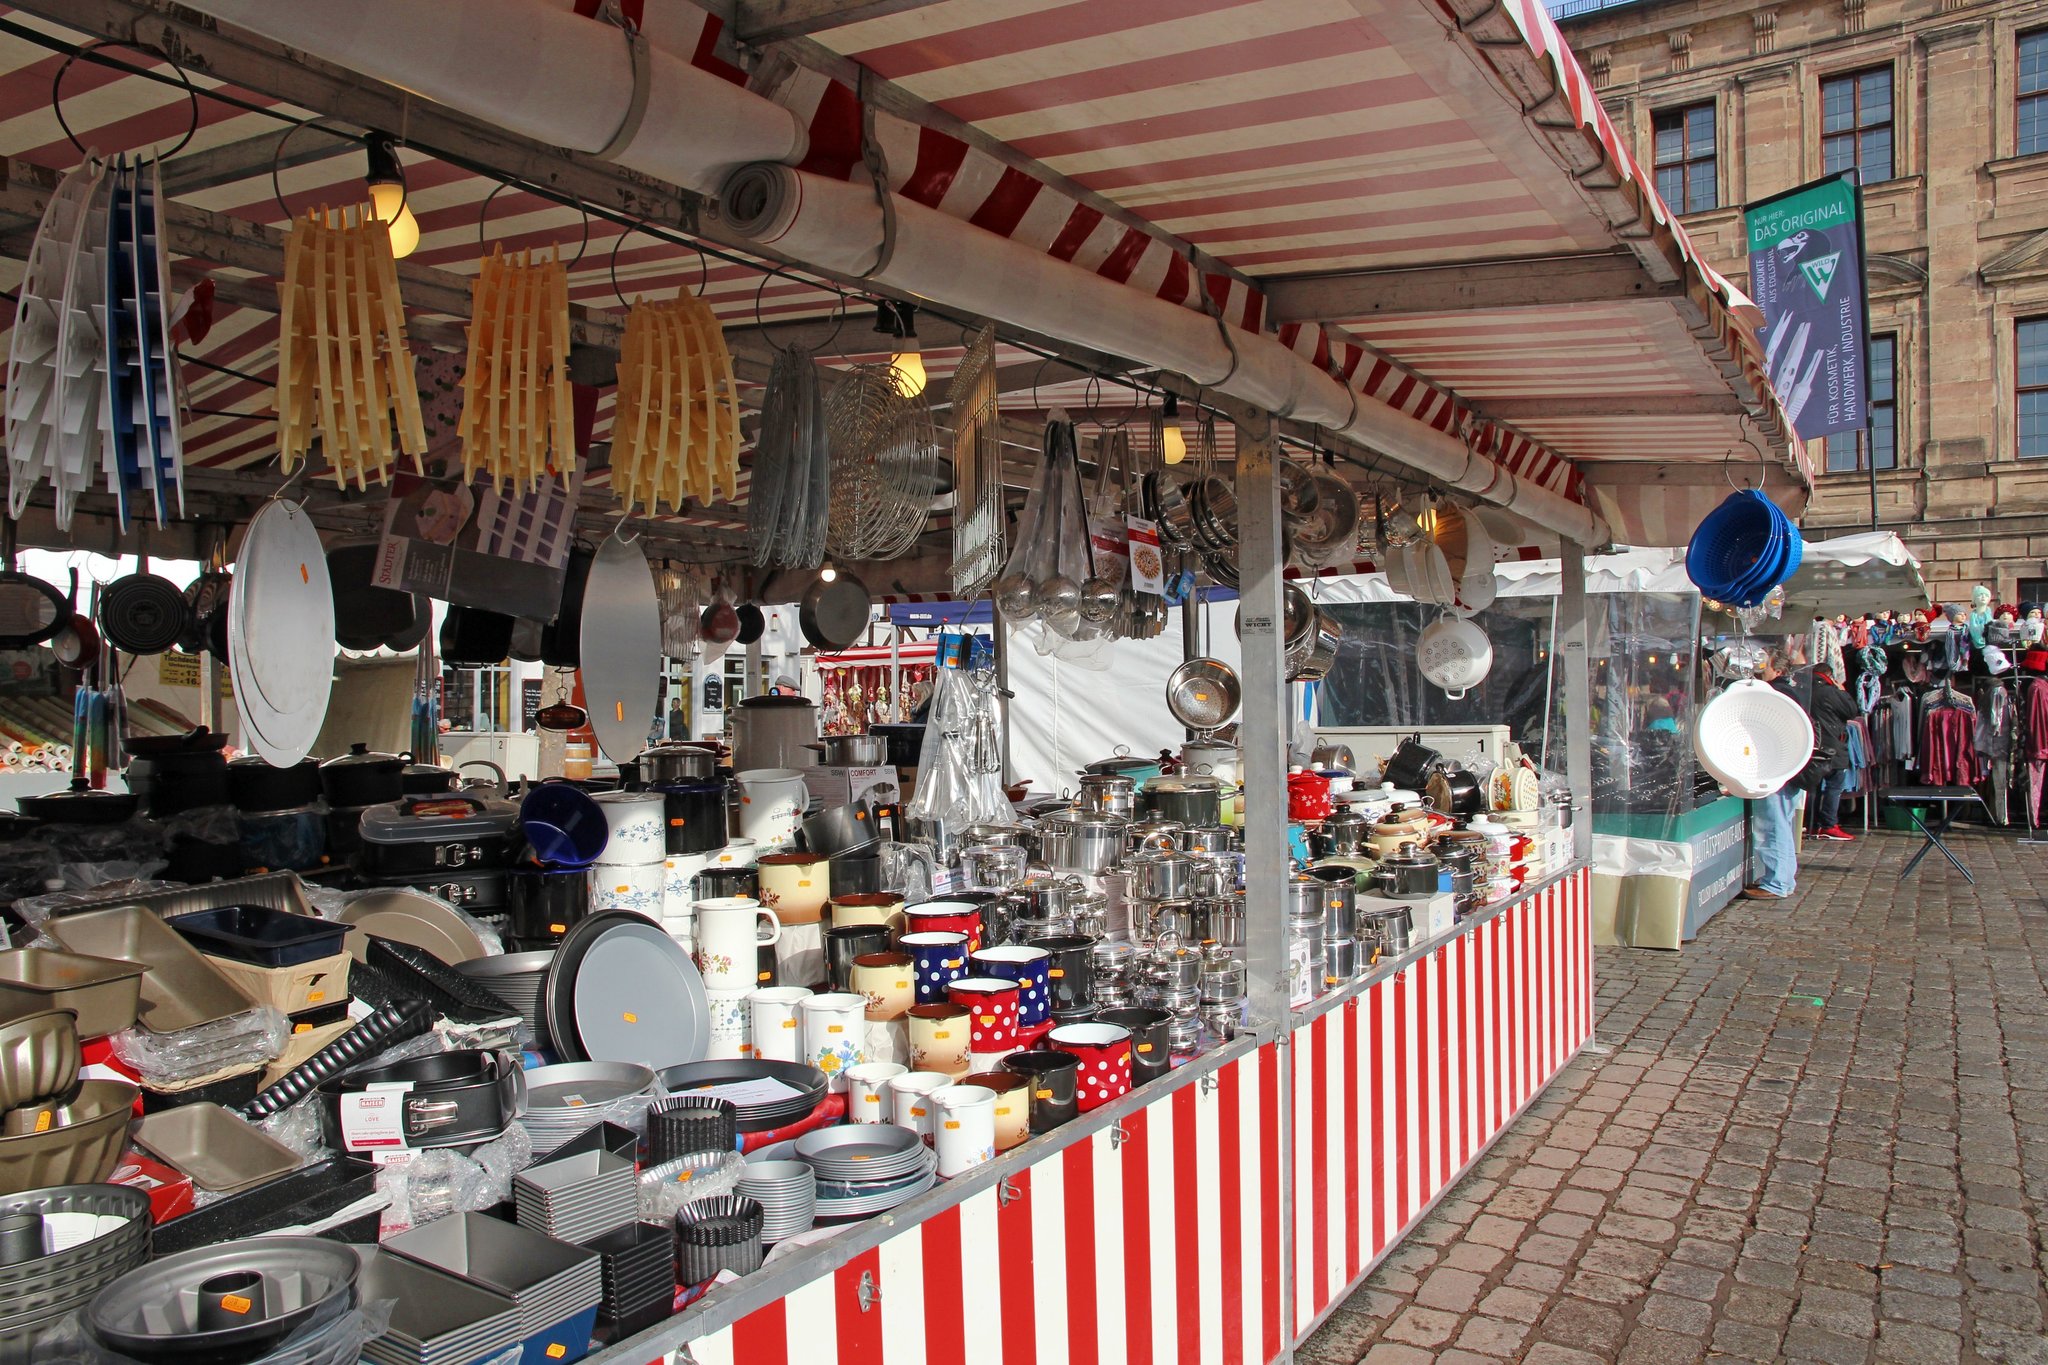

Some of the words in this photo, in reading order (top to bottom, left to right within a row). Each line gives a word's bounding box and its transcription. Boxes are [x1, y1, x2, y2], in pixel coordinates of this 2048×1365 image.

[1754, 215, 1767, 226] NUR
[1768, 210, 1785, 221] HIER:
[1755, 222, 1778, 241] DAS
[1781, 201, 1845, 232] ORIGINAL
[1767, 248, 1777, 288] EDELSTAHL
[1812, 258, 1830, 268] WILD
[1769, 289, 1778, 303] AUS
[1840, 296, 1854, 353] INDUSTRIE
[1826, 344, 1838, 400] KOSMETIK,
[1842, 354, 1857, 421] HANDWERK,
[1827, 403, 1839, 425] FÜR
[1477, 738, 1484, 752] 1
[850, 768, 877, 777] COMFORT
